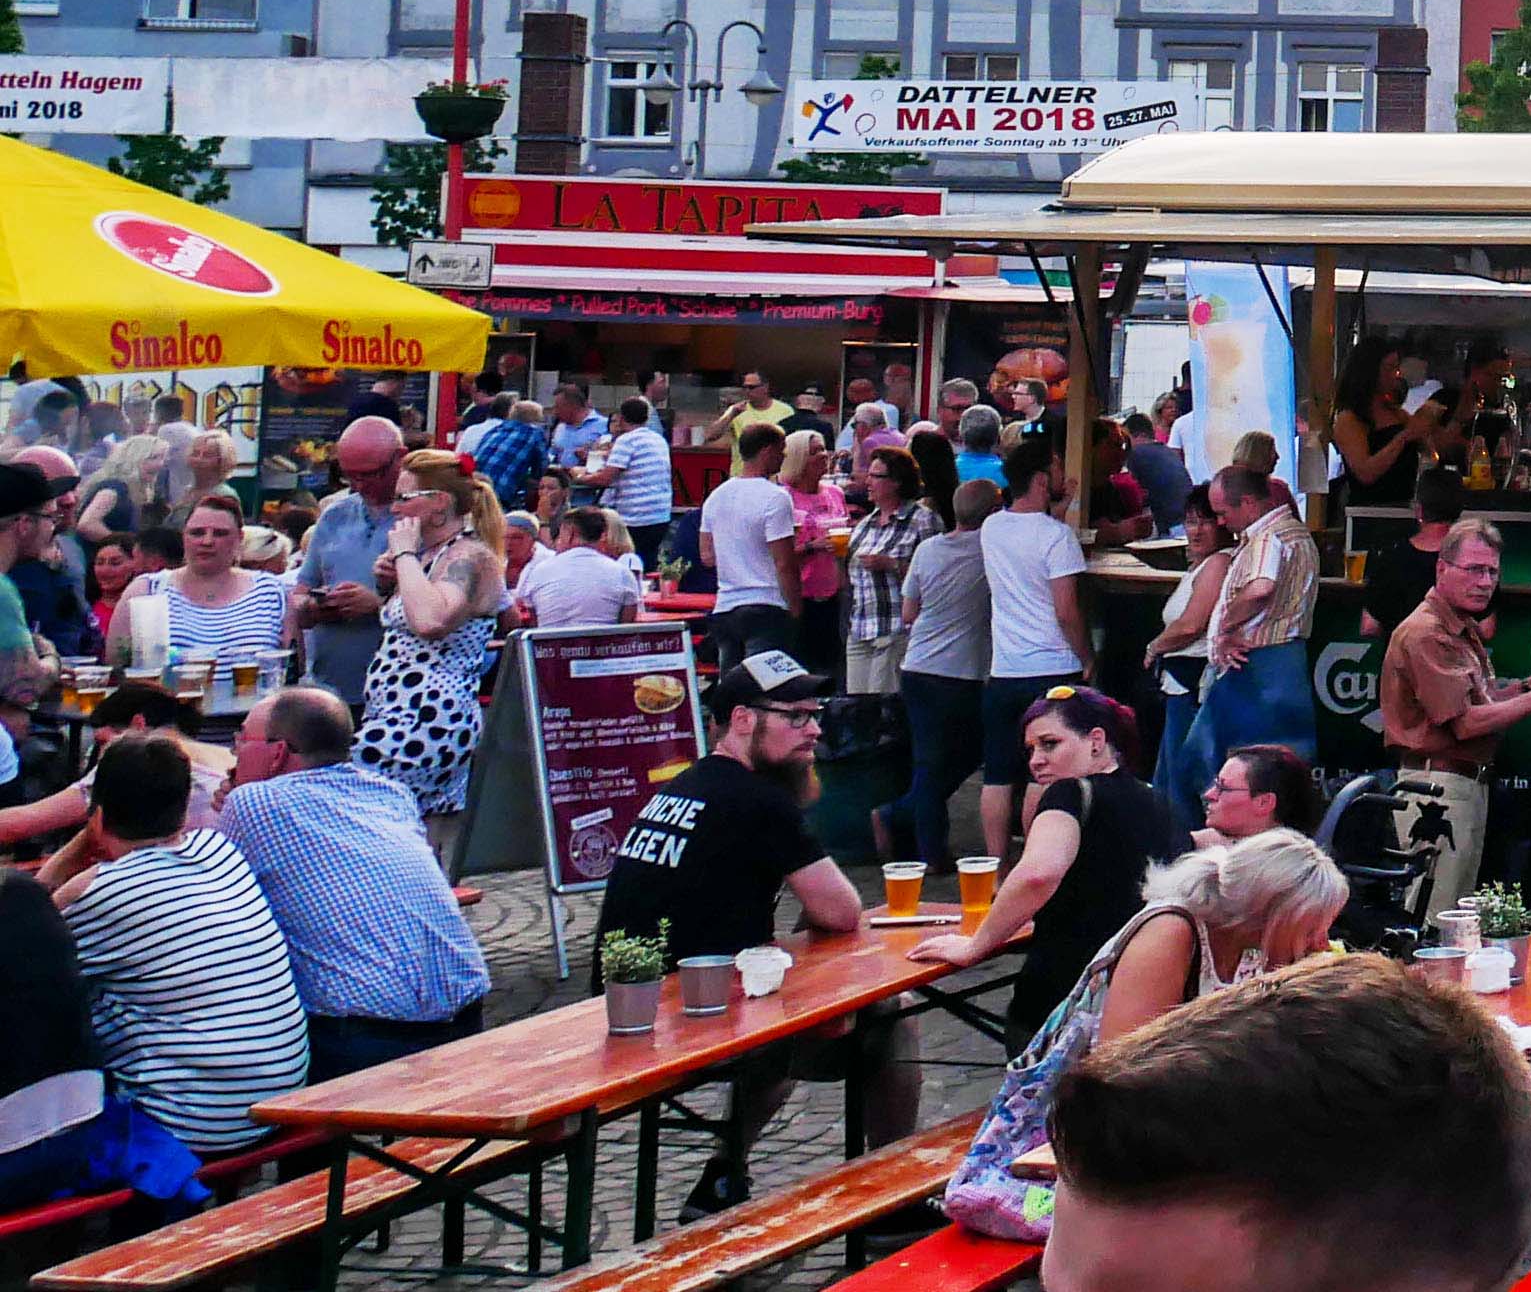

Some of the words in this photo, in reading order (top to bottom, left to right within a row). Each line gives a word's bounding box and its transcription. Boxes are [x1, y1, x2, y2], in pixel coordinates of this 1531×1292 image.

[60, 71, 143, 94] Hagem
[897, 86, 1097, 104] DATTELNER
[28, 101, 83, 119] 2018
[896, 108, 976, 131] MAI
[993, 108, 1095, 131] 2018
[1151, 104, 1174, 118] MAI
[864, 137, 980, 148] Verkaufsoffener
[984, 138, 1044, 149] Sonntag
[1049, 138, 1066, 147] ab
[551, 182, 626, 231] LA
[110, 320, 222, 369] Sinalco
[322, 319, 423, 366] Sinalco
[1513, 775, 1528, 789] in
